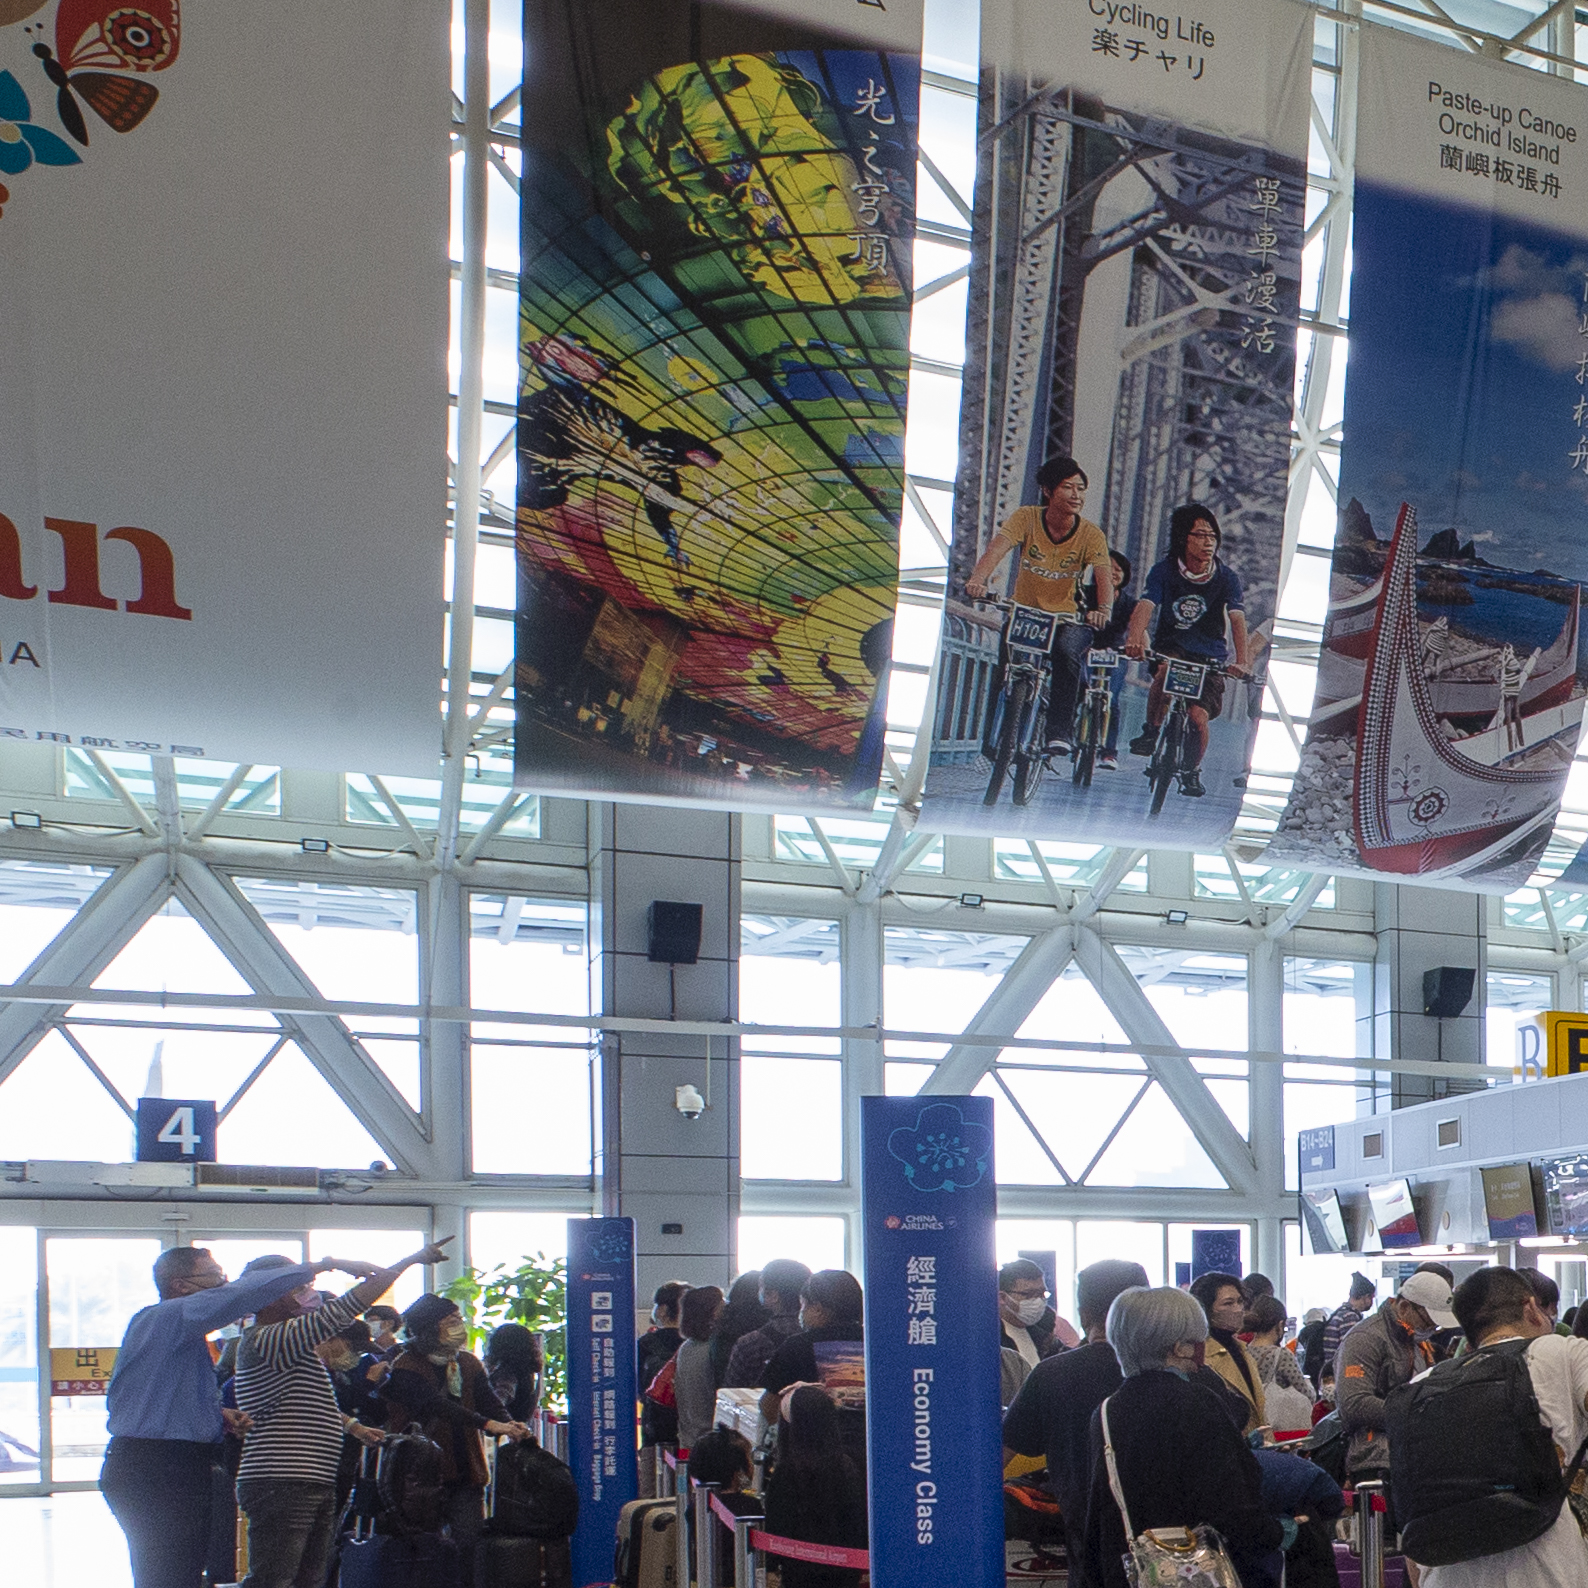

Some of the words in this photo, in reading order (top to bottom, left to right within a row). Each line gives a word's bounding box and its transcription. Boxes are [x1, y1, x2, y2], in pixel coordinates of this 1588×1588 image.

[1088, 0, 1169, 40] Cycling
[1177, 16, 1215, 48] Life
[1091, 27, 1205, 81] 楽チャリ
[1428, 81, 1513, 127] Paste-up
[1518, 108, 1577, 143] Canoe
[1438, 113, 1501, 147] Orchid
[1507, 130, 1560, 165] Island
[845, 78, 896, 275] 光之穹頂
[1439, 143, 1563, 199] 蘭嶼板張舟
[1240, 177, 1283, 354] 單車漫活
[157, 1107, 201, 1154] 4
[900, 1222, 944, 1231] AIRLINES
[905, 1214, 937, 1223] CHINA
[906, 1255, 938, 1345] 經濟艙
[910, 1368, 934, 1474] Economy
[914, 1481, 938, 1545] Class
